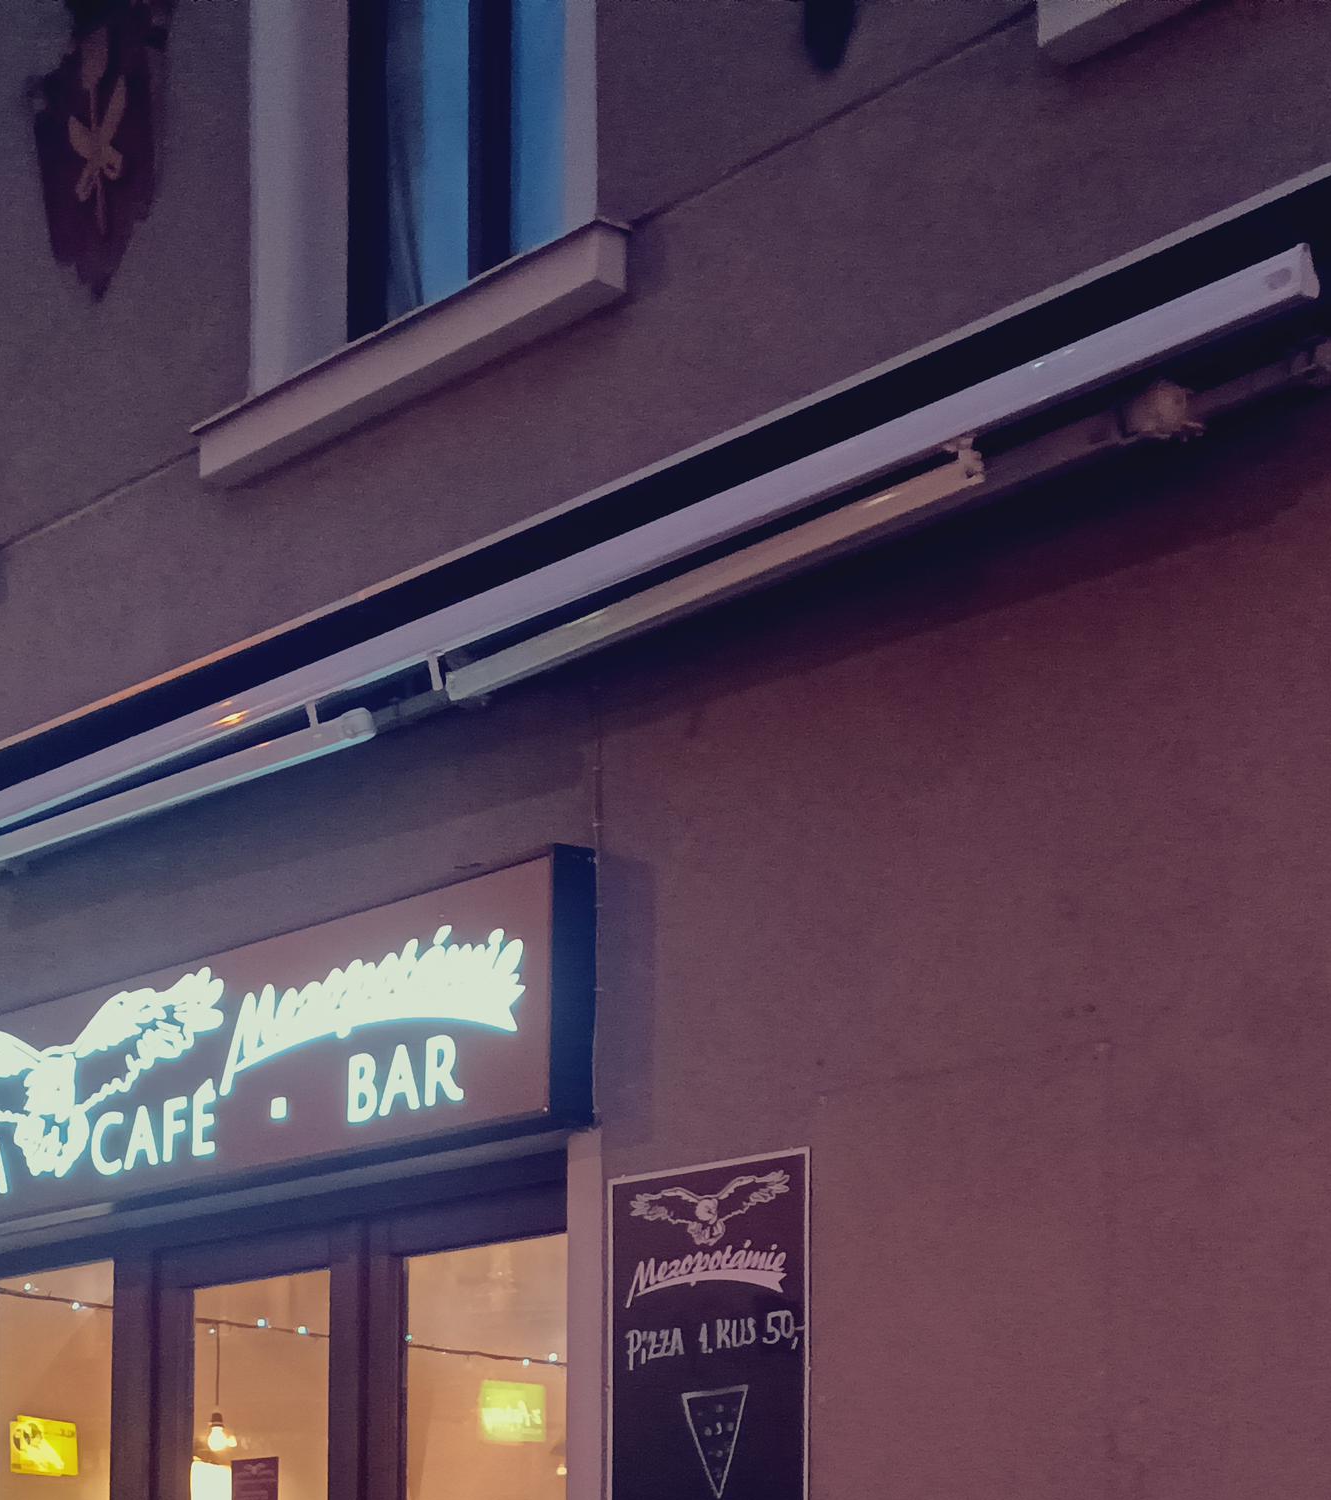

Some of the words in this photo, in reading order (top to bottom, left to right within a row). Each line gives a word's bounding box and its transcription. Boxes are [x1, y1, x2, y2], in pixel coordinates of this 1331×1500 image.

[90, 1078, 217, 1177] CAFÉ
[346, 1034, 465, 1130] BAR
[625, 1239, 788, 1309] Mezopotámie
